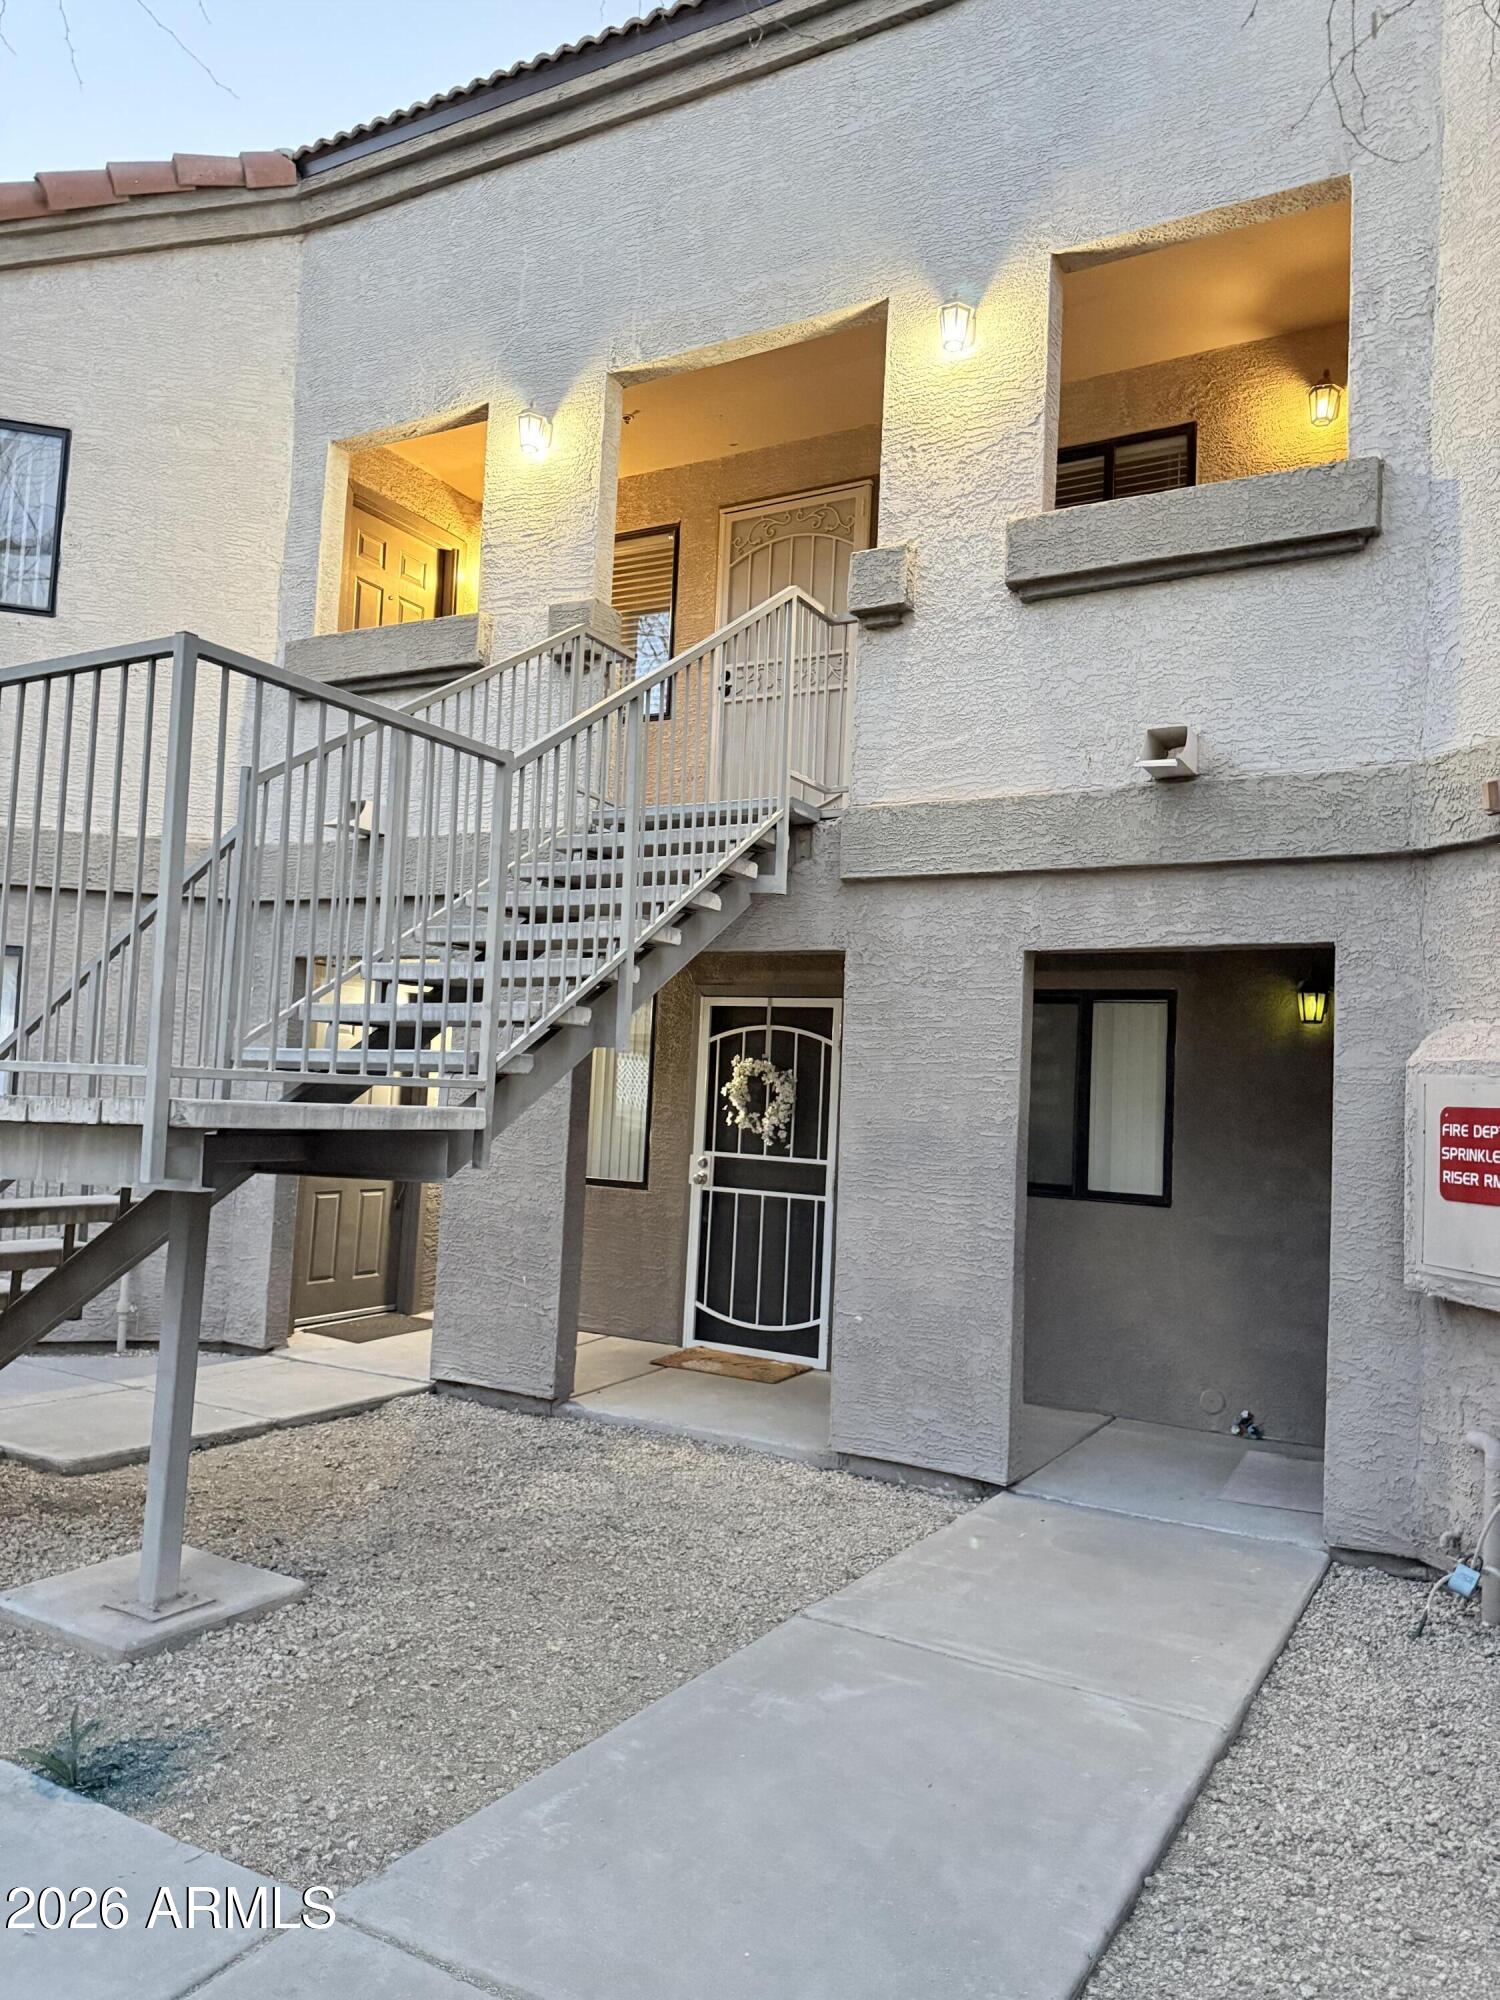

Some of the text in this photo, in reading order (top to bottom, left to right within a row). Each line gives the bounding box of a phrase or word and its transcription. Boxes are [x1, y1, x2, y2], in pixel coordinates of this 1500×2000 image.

[1442, 1123, 1500, 1139] FIRE DEP
[1441, 1146, 1500, 1164] SPRINKLE
[1442, 1169, 1480, 1187] RISER
